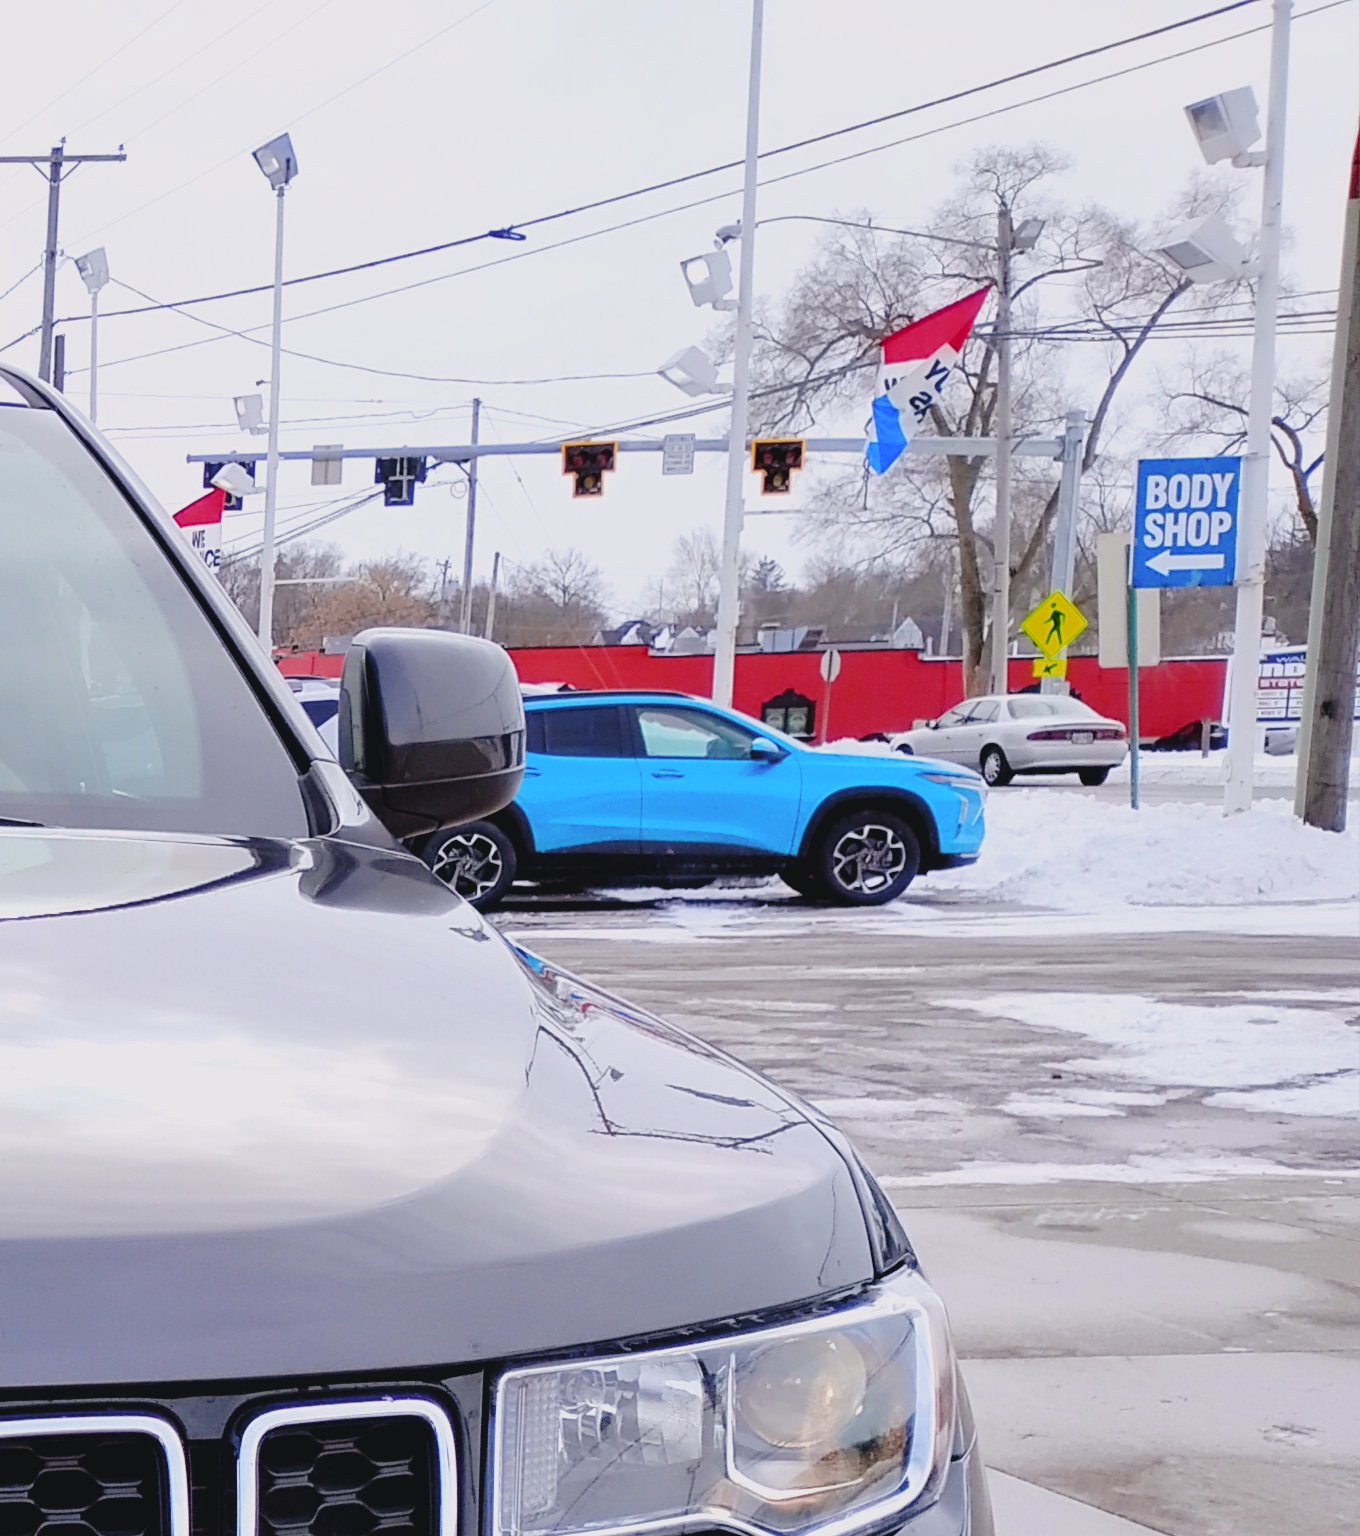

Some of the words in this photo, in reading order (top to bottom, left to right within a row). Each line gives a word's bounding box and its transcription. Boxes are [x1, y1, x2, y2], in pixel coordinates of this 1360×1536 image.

[1145, 473, 1235, 510] BODY
[192, 530, 206, 549] WE
[1143, 511, 1232, 548] SHOP
